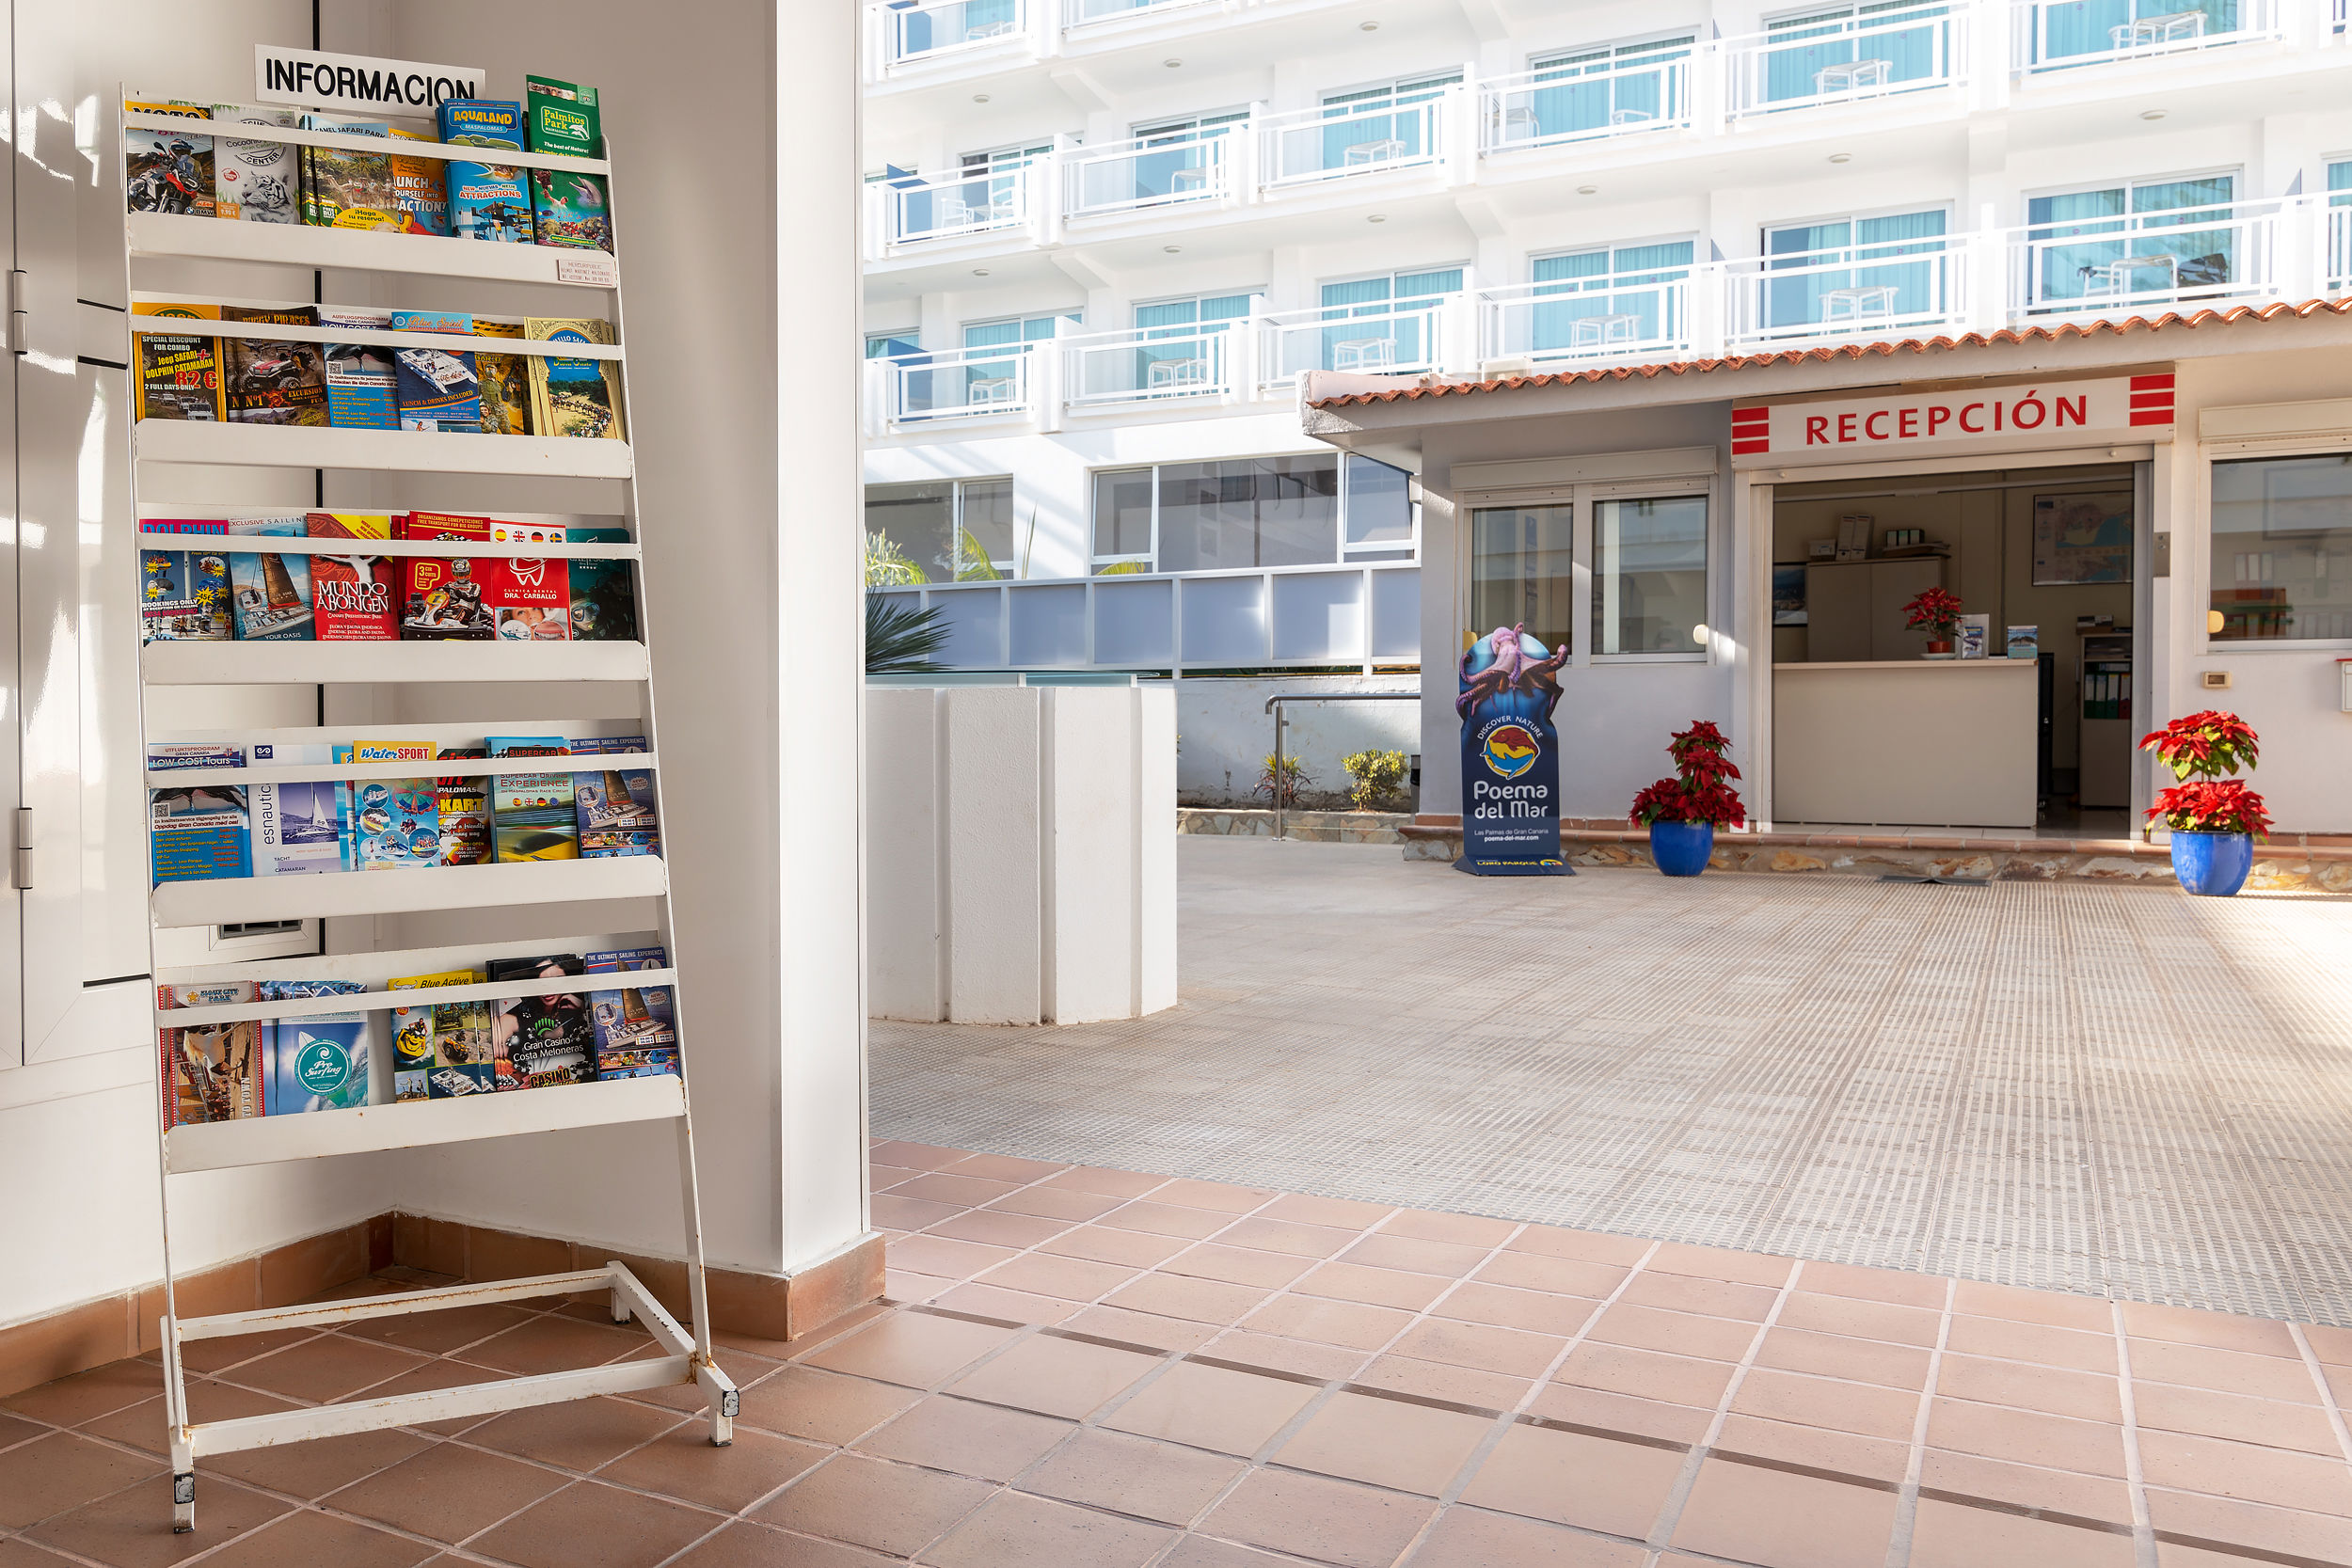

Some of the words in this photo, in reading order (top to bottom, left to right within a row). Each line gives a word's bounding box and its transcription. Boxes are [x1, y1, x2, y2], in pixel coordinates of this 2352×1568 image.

[265, 58, 475, 107] INFORMACION
[454, 110, 513, 125] AQUALAND
[544, 109, 585, 125] Palmitos
[545, 118, 568, 130] Park
[365, 130, 386, 138] PARK
[246, 152, 279, 164] CENTER
[459, 190, 522, 199] ATTRACTIONS
[398, 200, 447, 213] ACTION!
[274, 314, 310, 325] PIRATES
[407, 316, 432, 326] Blue
[158, 356, 174, 365] Jeep
[174, 350, 197, 361] SAFARI
[145, 366, 174, 379] DOLPHIN
[175, 358, 214, 372] CATAMARAN
[175, 371, 201, 388] 82
[204, 371, 218, 389] €
[288, 387, 323, 398] EXCURSION
[427, 396, 447, 405] DRINKS
[448, 390, 473, 402] INCLUDED
[1806, 389, 2086, 445] RECEPCIÓN
[143, 524, 224, 535] DOLPHIN
[419, 567, 425, 576] 3
[317, 580, 387, 597] MUNDO
[316, 594, 388, 613] ABORIGEN
[1477, 715, 1512, 740] DISCOVER
[1515, 716, 1543, 739] NATURE
[361, 747, 429, 759] WaterSPORT
[153, 759, 176, 768] LOW
[177, 757, 204, 766] COST
[1474, 780, 1549, 800] Poema
[1475, 802, 1504, 819] del
[1511, 801, 1549, 818] Mar
[420, 979, 440, 988] Blue
[442, 977, 469, 987] Active
[523, 1041, 543, 1051] Gran
[545, 1037, 571, 1047] Casino
[513, 1051, 538, 1062] Costa
[540, 1045, 584, 1058] Meloneras
[305, 1065, 342, 1078] Surfing
[314, 1060, 333, 1069] Pro
[530, 1068, 571, 1088] CASINO
[240, 1077, 251, 1102] TOWN
[241, 1104, 252, 1118] TO
